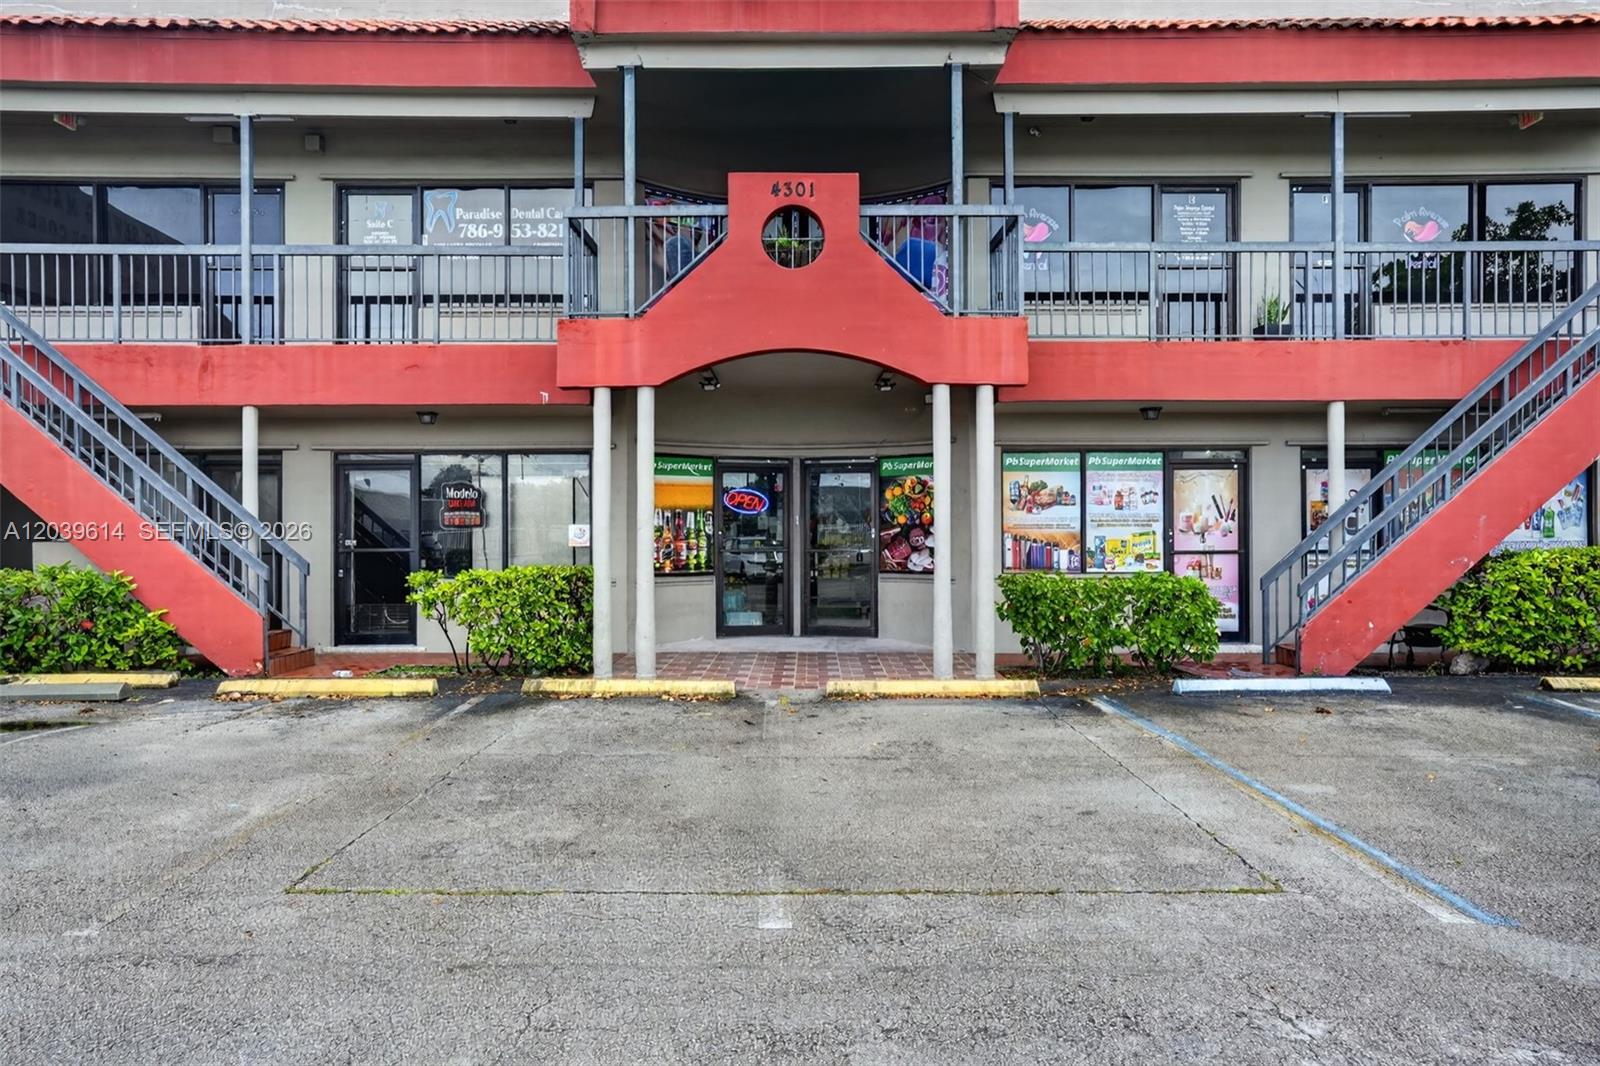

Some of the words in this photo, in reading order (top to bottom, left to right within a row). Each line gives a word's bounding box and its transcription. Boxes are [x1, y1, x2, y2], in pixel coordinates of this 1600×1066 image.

[770, 180, 815, 198] 4301
[456, 207, 503, 220] Paradise
[511, 207, 544, 220] Dental
[1393, 210, 1418, 227] Palm
[445, 487, 479, 499] Modelo
[727, 491, 764, 511] OPEN
